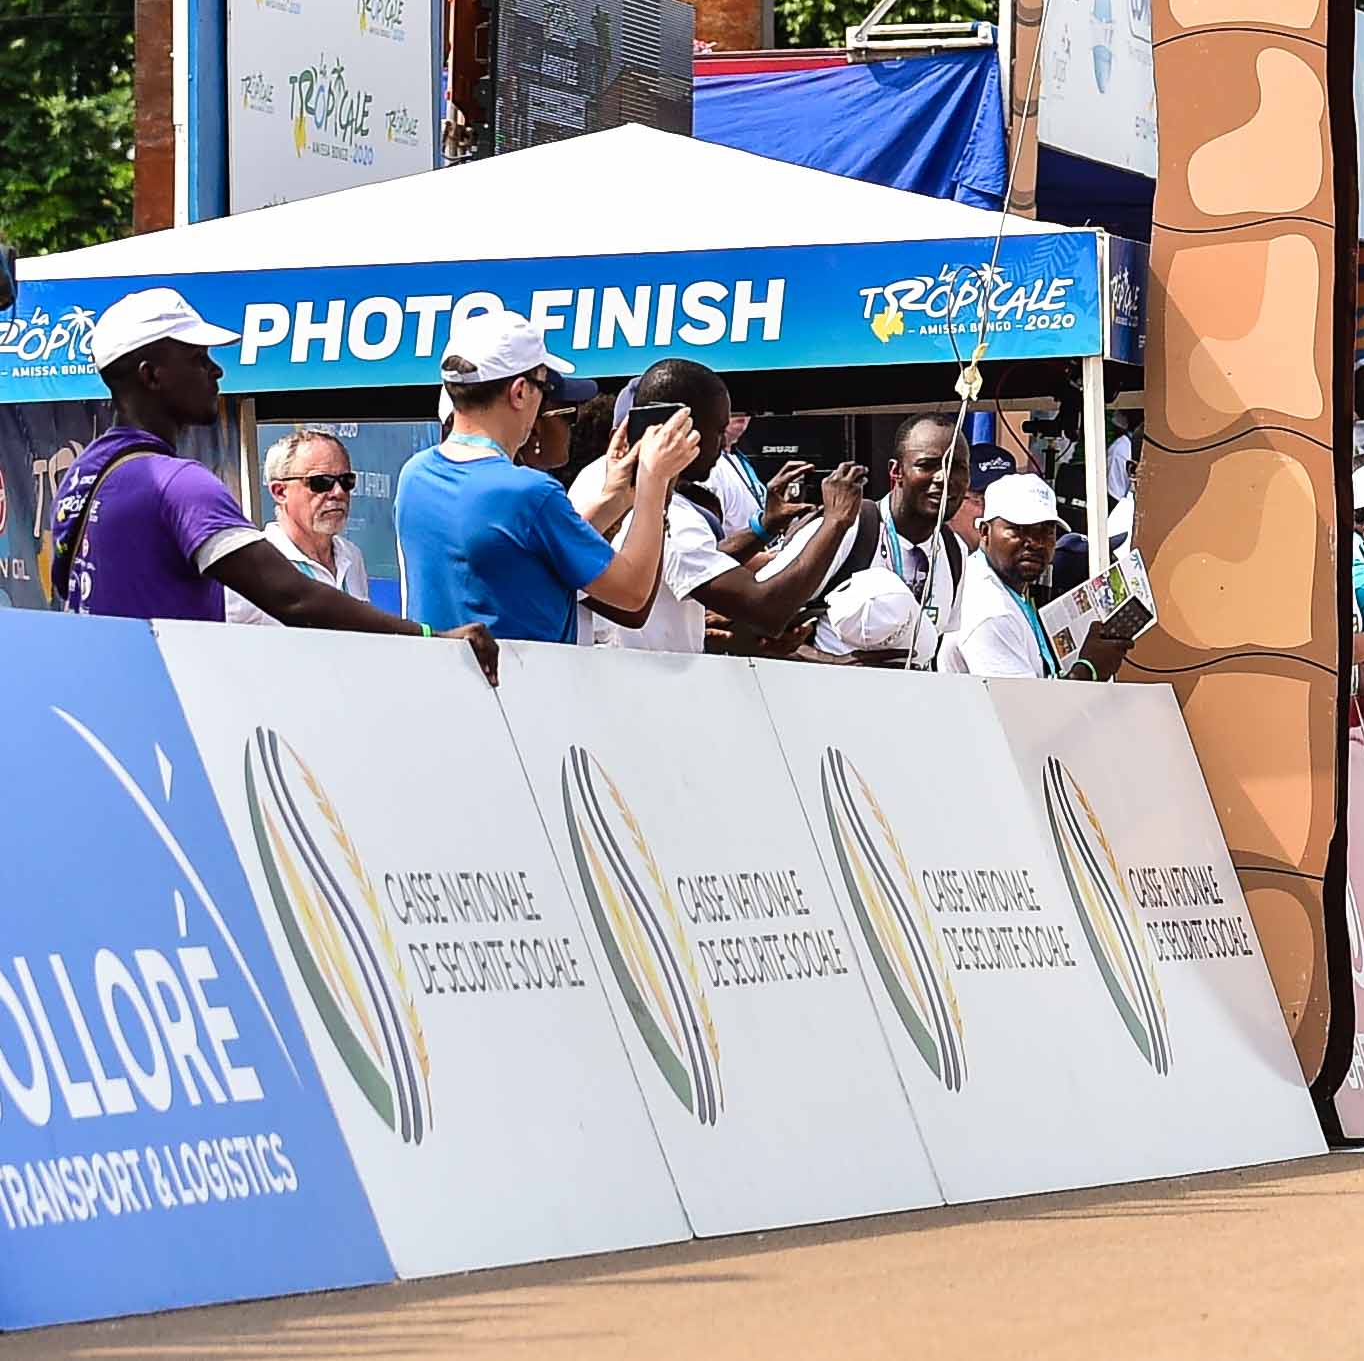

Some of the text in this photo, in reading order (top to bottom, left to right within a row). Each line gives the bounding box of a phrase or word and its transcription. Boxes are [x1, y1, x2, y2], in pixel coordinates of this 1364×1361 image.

[289, 66, 372, 145] TROPICALE
[529, 279, 786, 351] FINISH
[859, 277, 1075, 326] TROPICALE
[919, 323, 967, 336] AMISSA
[1024, 314, 1076, 332] 2020
[12, 364, 97, 377] AMISSA BONG
[761, 445, 799, 454] SHURE
[384, 871, 542, 925] CAISSE NATIONALE
[677, 870, 810, 925] CAISSE NATIONALE
[922, 869, 1041, 913] CAISSE NATIONALE
[1159, 865, 1224, 908] NATIONALE
[408, 942, 445, 995] DE
[510, 937, 586, 990] SOCIALE
[698, 939, 730, 988] DE
[784, 928, 849, 980] SOCIALE
[942, 927, 971, 971] DE
[1018, 925, 1077, 968] SOCIALE
[0, 889, 265, 1127] OLLORÉ
[0, 1132, 298, 1230] TRANSPORT & LOGISTICS
